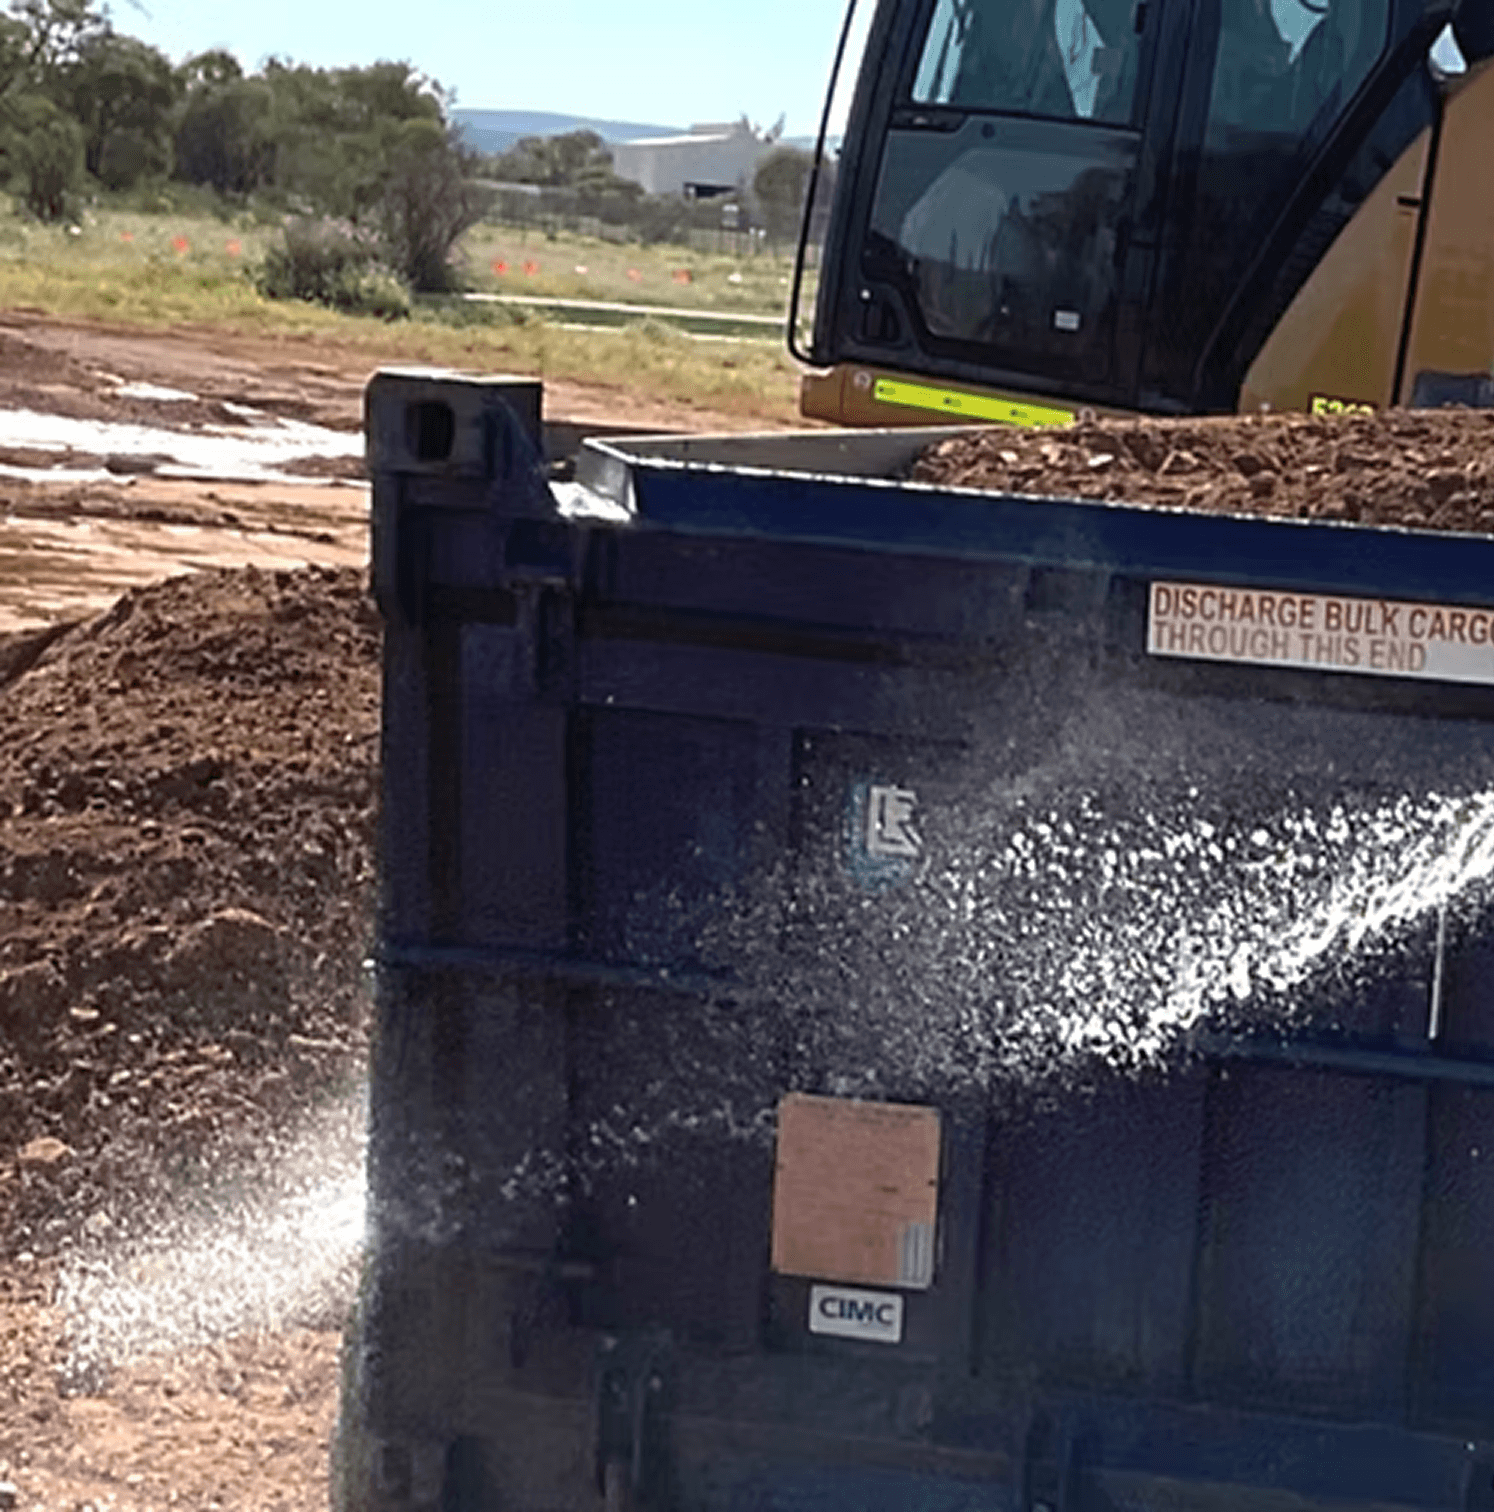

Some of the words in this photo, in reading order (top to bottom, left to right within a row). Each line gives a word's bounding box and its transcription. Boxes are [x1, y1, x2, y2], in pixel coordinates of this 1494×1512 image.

[1154, 585, 1316, 629] DISCHARGE
[1325, 600, 1400, 637] BULK
[1154, 620, 1289, 659] THROUGH
[1300, 633, 1361, 667] THIS
[1369, 638, 1427, 672] END
[818, 1296, 896, 1326] CIMC
